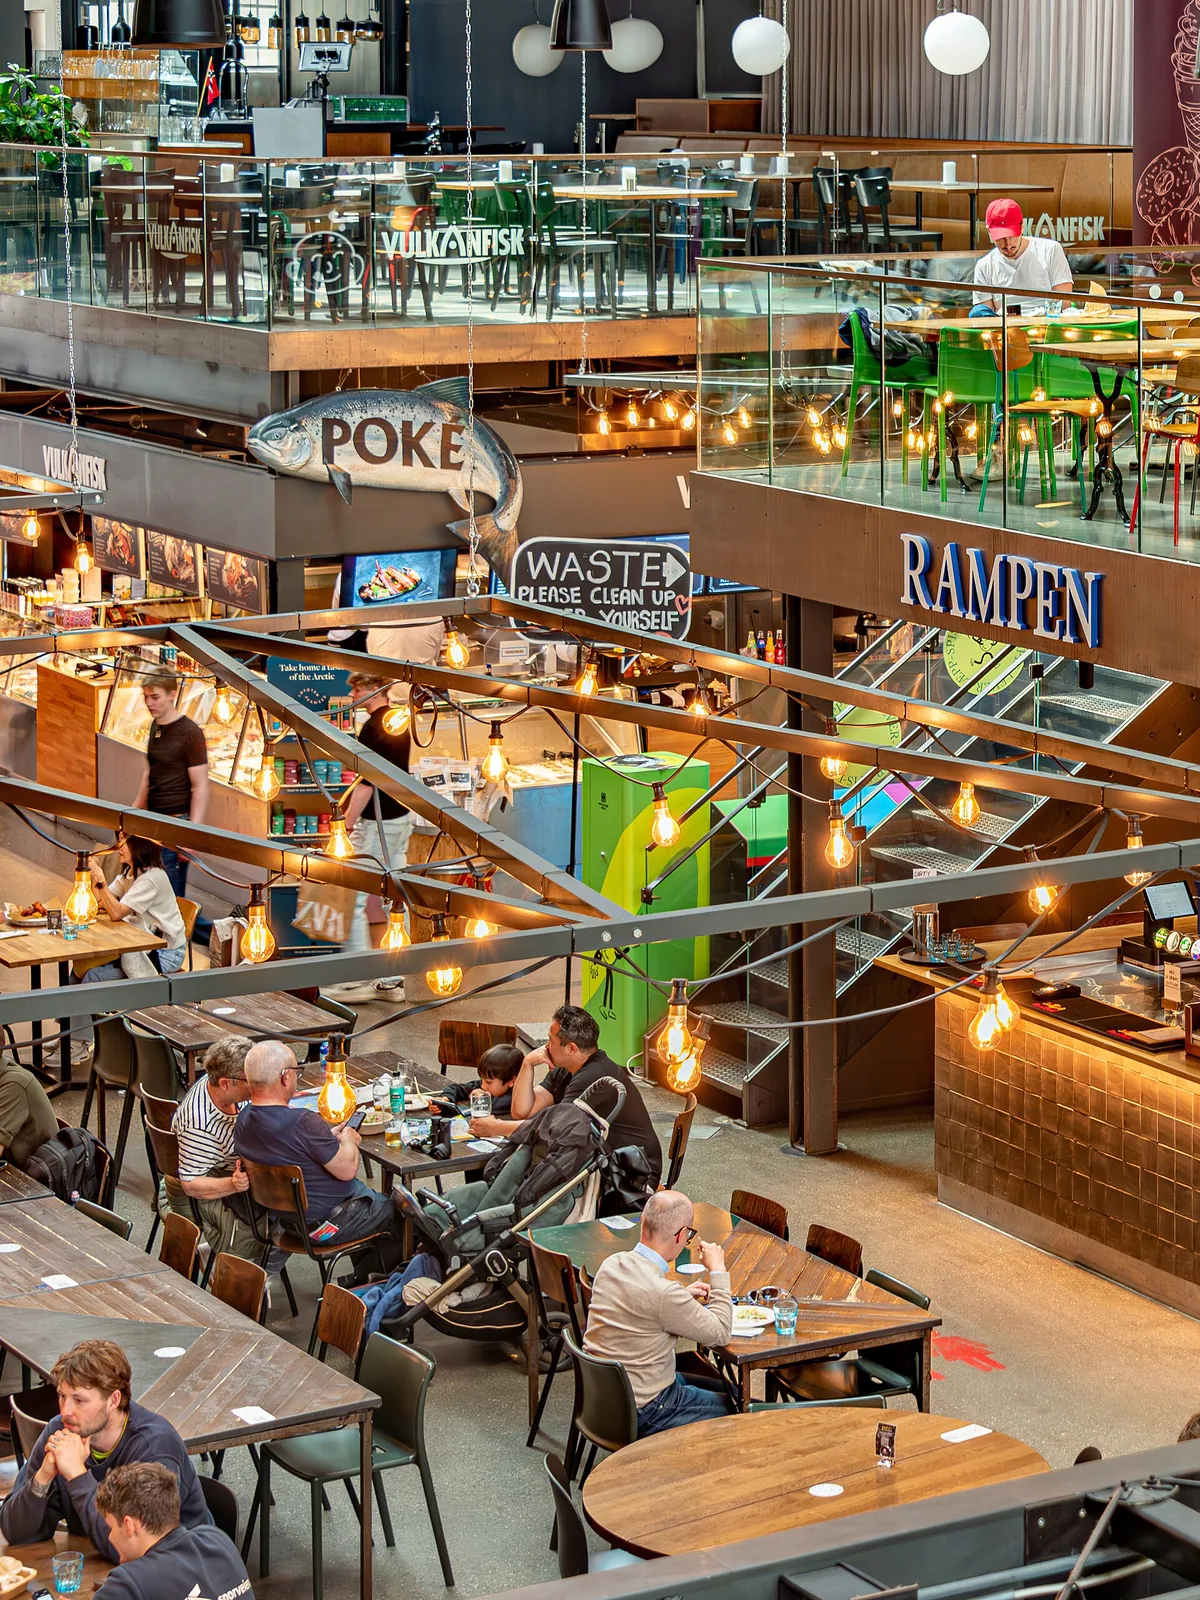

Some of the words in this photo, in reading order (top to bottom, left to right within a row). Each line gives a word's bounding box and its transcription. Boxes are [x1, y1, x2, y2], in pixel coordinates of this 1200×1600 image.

[148, 221, 201, 254] VULKANFISK
[381, 223, 525, 259] VULKANFISK
[322, 416, 466, 471] POKÉ
[527, 550, 661, 588] WASTE
[518, 585, 582, 604] PLEASE
[590, 586, 644, 606] CLEAN
[652, 589, 677, 607] UP
[900, 533, 1104, 648] RAMPEN
[599, 608, 679, 631] YOURSELF
[279, 664, 298, 672] Take
[299, 664, 321, 672] home
[289, 673, 299, 681] of
[299, 673, 312, 681] the
[312, 672, 336, 681] Arctic
[915, 870, 931, 878] DIRTY
